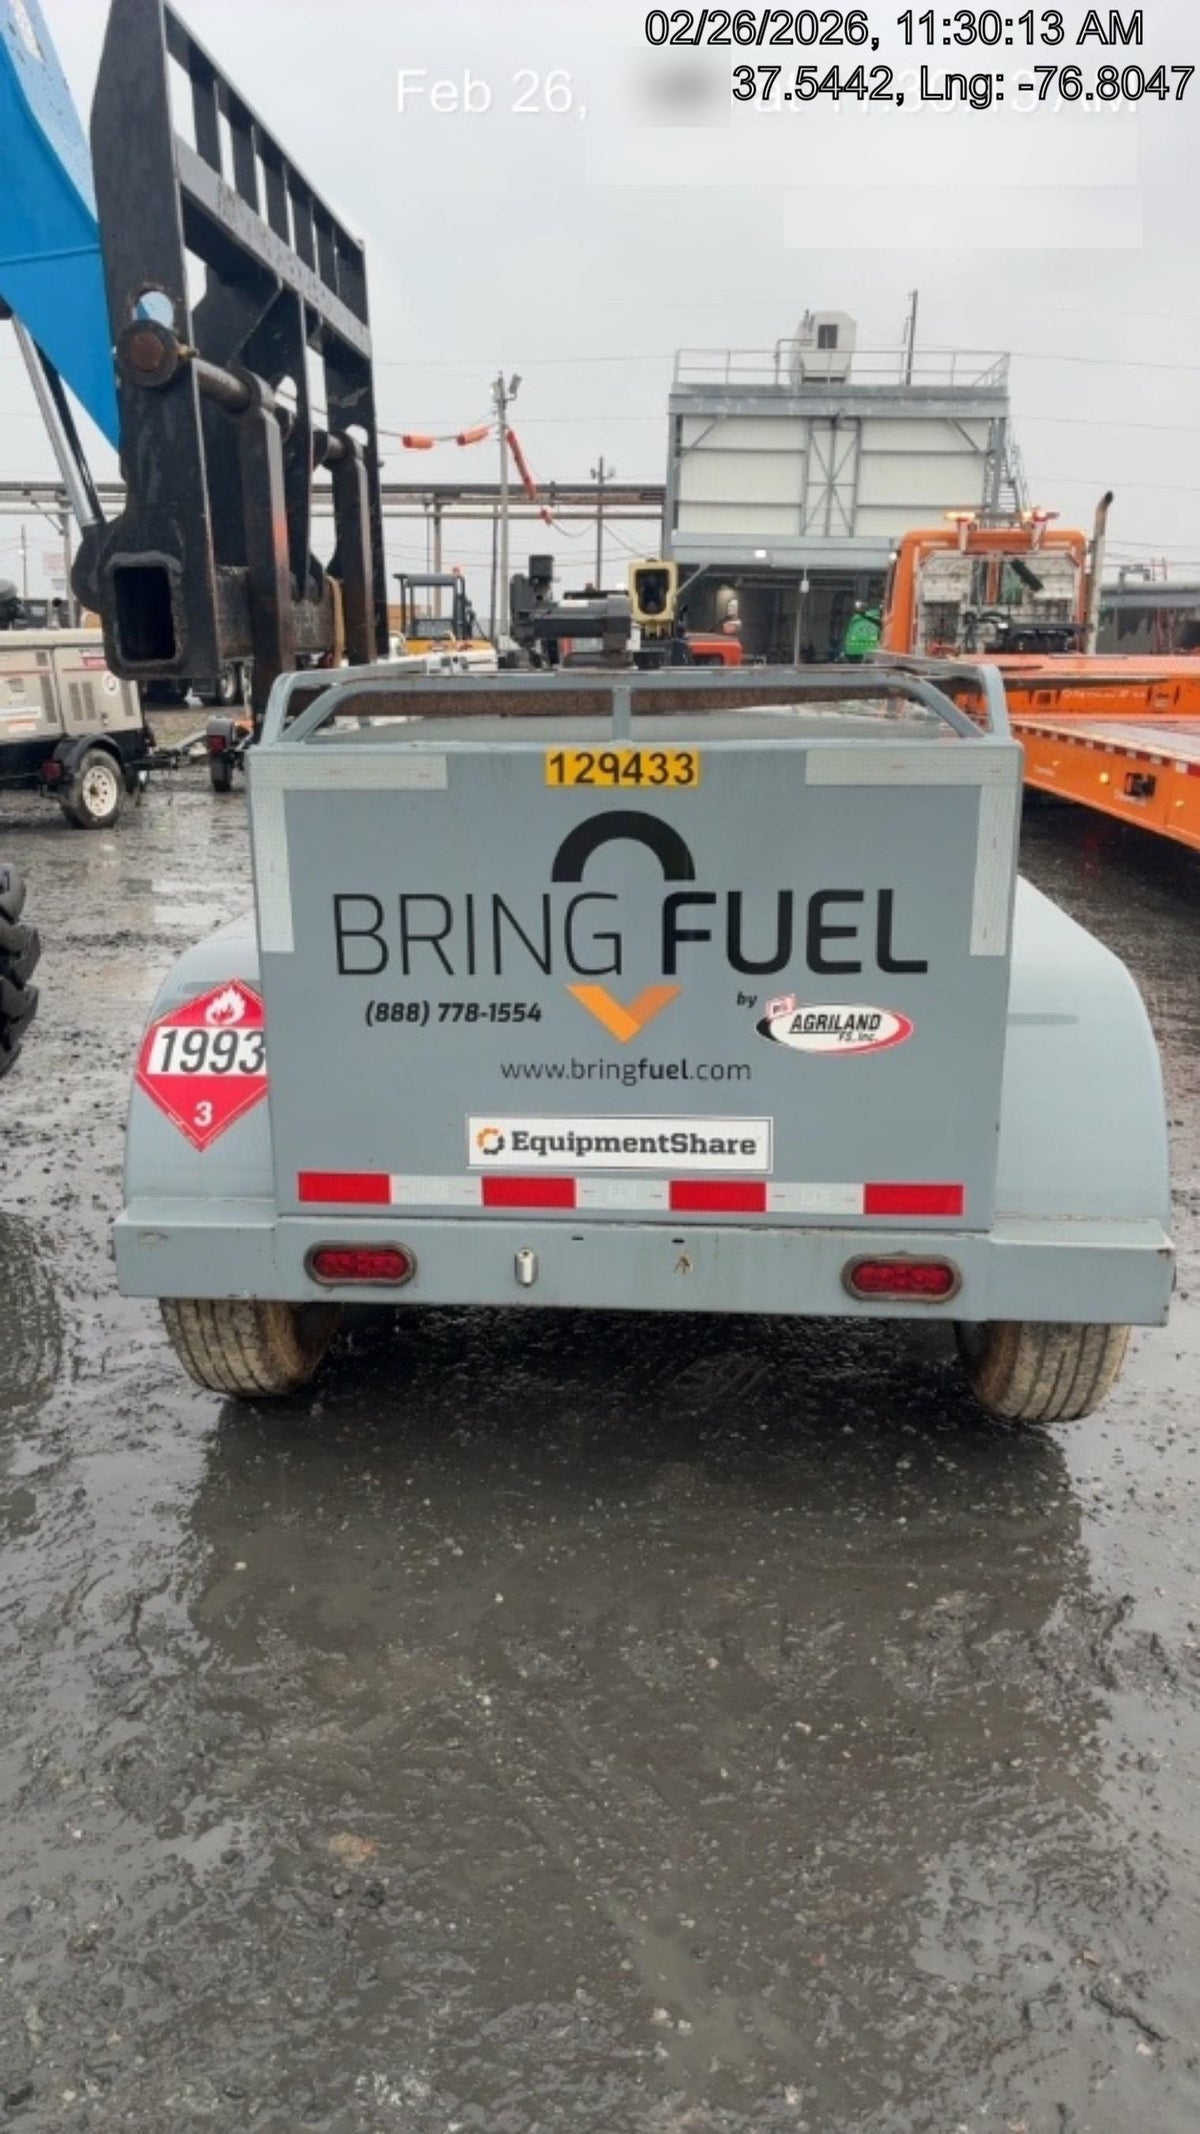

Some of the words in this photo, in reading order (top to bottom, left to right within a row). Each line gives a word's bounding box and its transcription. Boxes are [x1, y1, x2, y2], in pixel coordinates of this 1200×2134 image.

[548, 752, 695, 786] 129433
[333, 892, 623, 976] BRING
[661, 888, 929, 976] FUEL
[736, 991, 758, 1008] by
[365, 1000, 430, 1028] (888)
[438, 1002, 542, 1023] 778-1554
[791, 1014, 882, 1032] AGRILAND
[160, 1029, 266, 1074] 1993
[500, 1058, 752, 1087] www.bringfuel.com
[193, 1101, 213, 1127] 3
[511, 1130, 757, 1157] EquipmentShare
